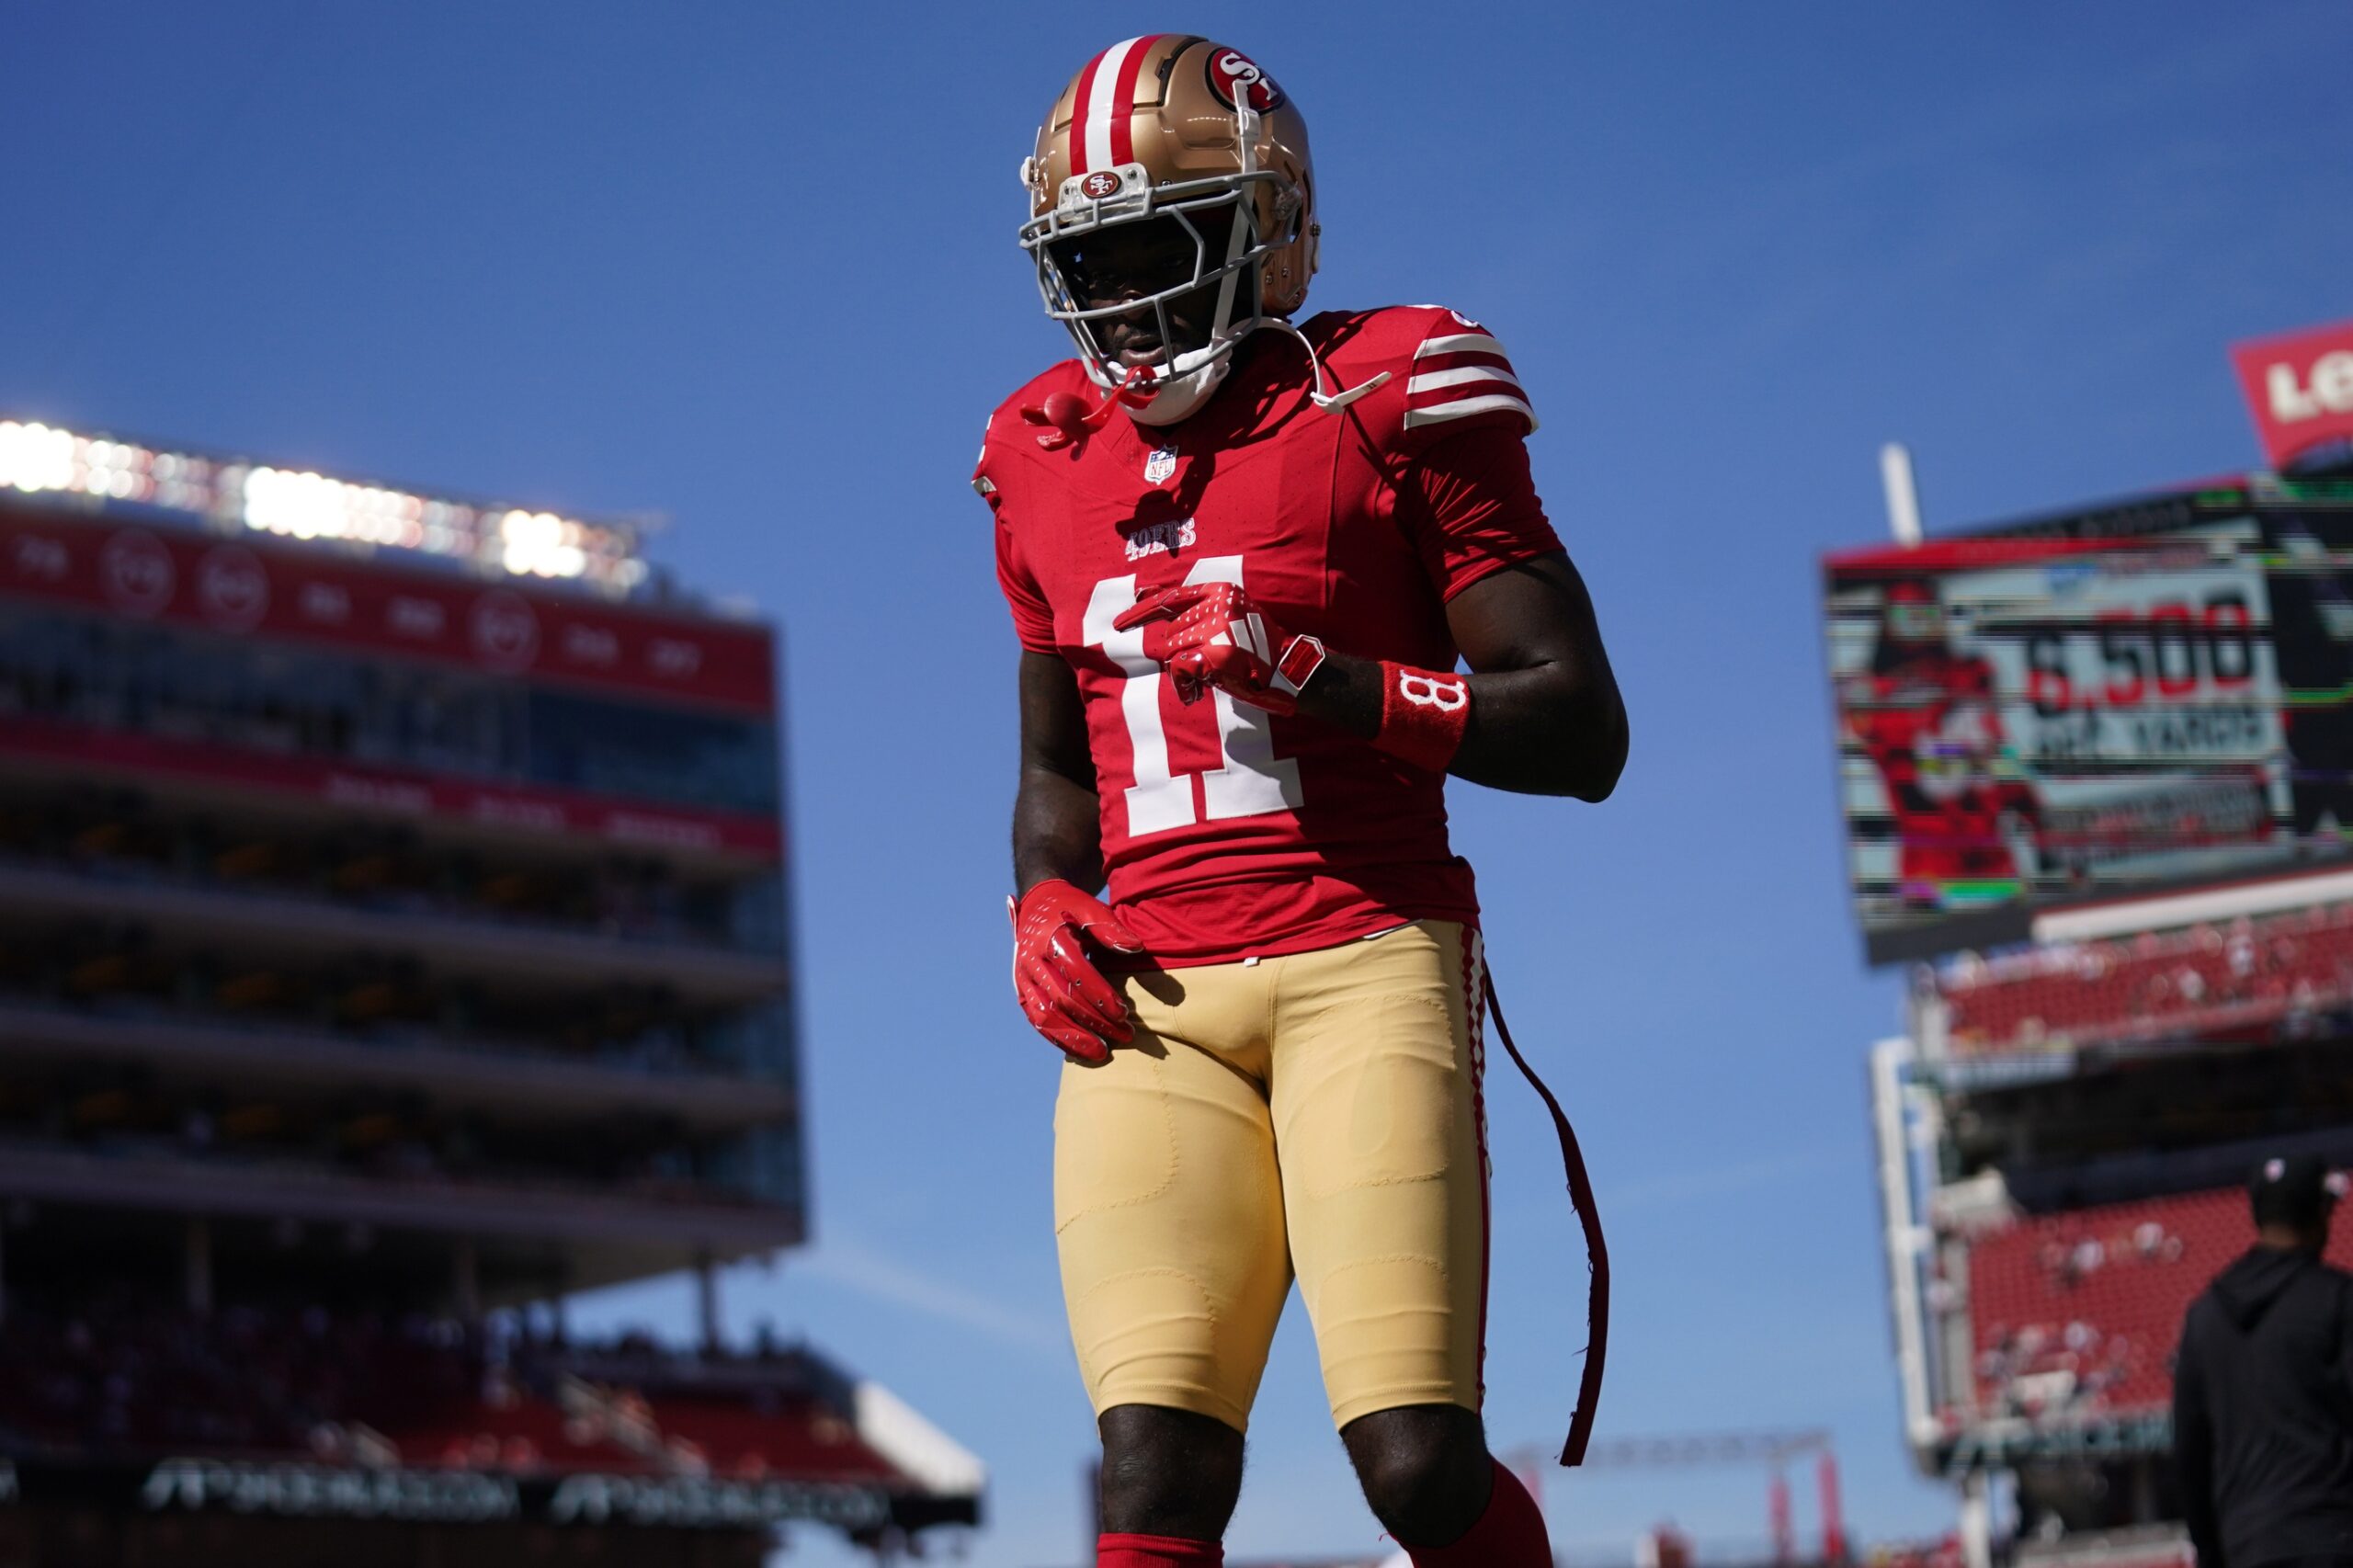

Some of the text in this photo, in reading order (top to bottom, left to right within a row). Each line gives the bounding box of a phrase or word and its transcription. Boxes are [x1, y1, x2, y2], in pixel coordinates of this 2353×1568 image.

[1150, 460, 1172, 476] NFL
[1125, 517, 1196, 561] 49ERS
[1083, 554, 1304, 838] 11
